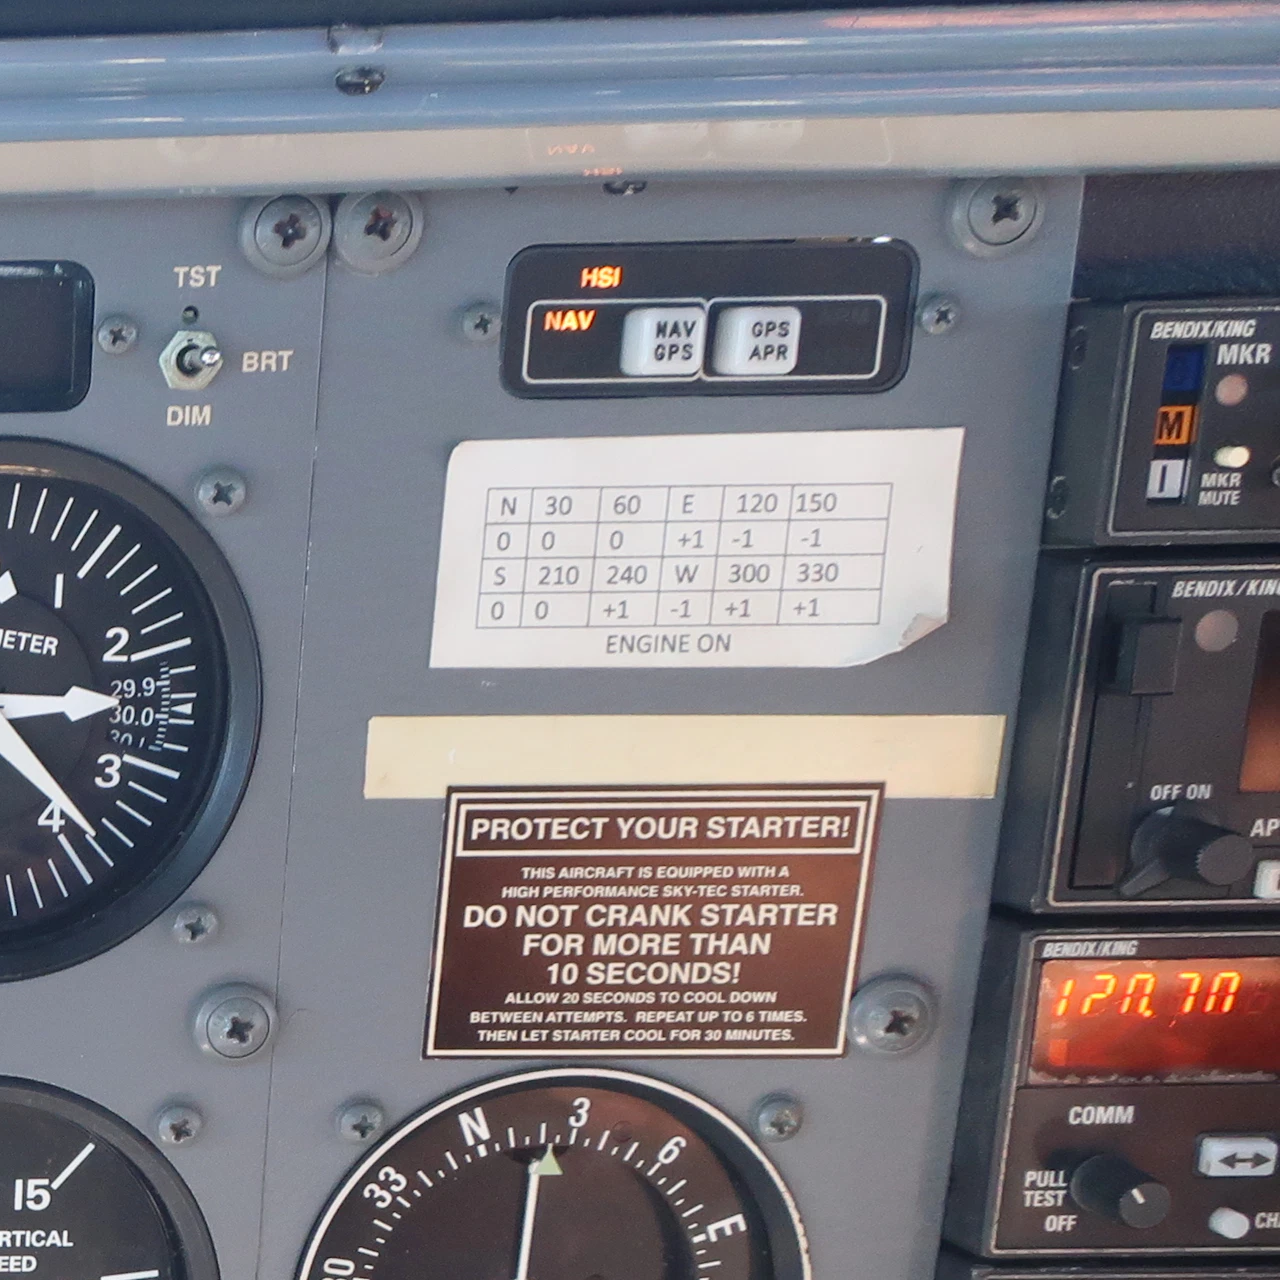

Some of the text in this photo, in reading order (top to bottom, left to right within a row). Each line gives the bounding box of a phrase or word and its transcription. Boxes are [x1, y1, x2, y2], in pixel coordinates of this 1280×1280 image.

[174, 265, 221, 287] TST
[581, 267, 620, 288] HSI
[545, 310, 594, 330] NAV
[656, 321, 696, 338] NAV
[752, 321, 790, 338] GPS
[1151, 319, 1256, 339] BENDIX/KING
[243, 351, 293, 372] BRT
[654, 343, 693, 361] GPS
[749, 344, 788, 360] APR
[1217, 344, 1271, 365] MKR
[167, 405, 210, 426] DIM
[1201, 473, 1241, 487] MKR
[501, 493, 837, 516] N 30 60 E 120 150
[1198, 490, 1240, 505] MUTE
[494, 563, 838, 586] S 210 240 W 300 330
[606, 634, 731, 654] ENGINE ON
[110, 678, 155, 699] 29.9
[472, 816, 850, 840] PROTECT YOUR STARTER!
[522, 866, 789, 879] THIS AIRCRAFT IS EQUIPPED WITH A
[502, 885, 804, 898] HIGH PERFORMANCE SKY-TEC STARTER.
[464, 904, 838, 927] DO NOT CRANK STARTER
[523, 933, 771, 956] FOR MORE THAN
[548, 962, 740, 984] 10 SECONDS!
[1069, 1106, 1134, 1124] COMM
[1024, 1171, 1067, 1187] PULL
[1023, 1190, 1066, 1207] TEST
[1045, 1215, 1077, 1231] OFF
